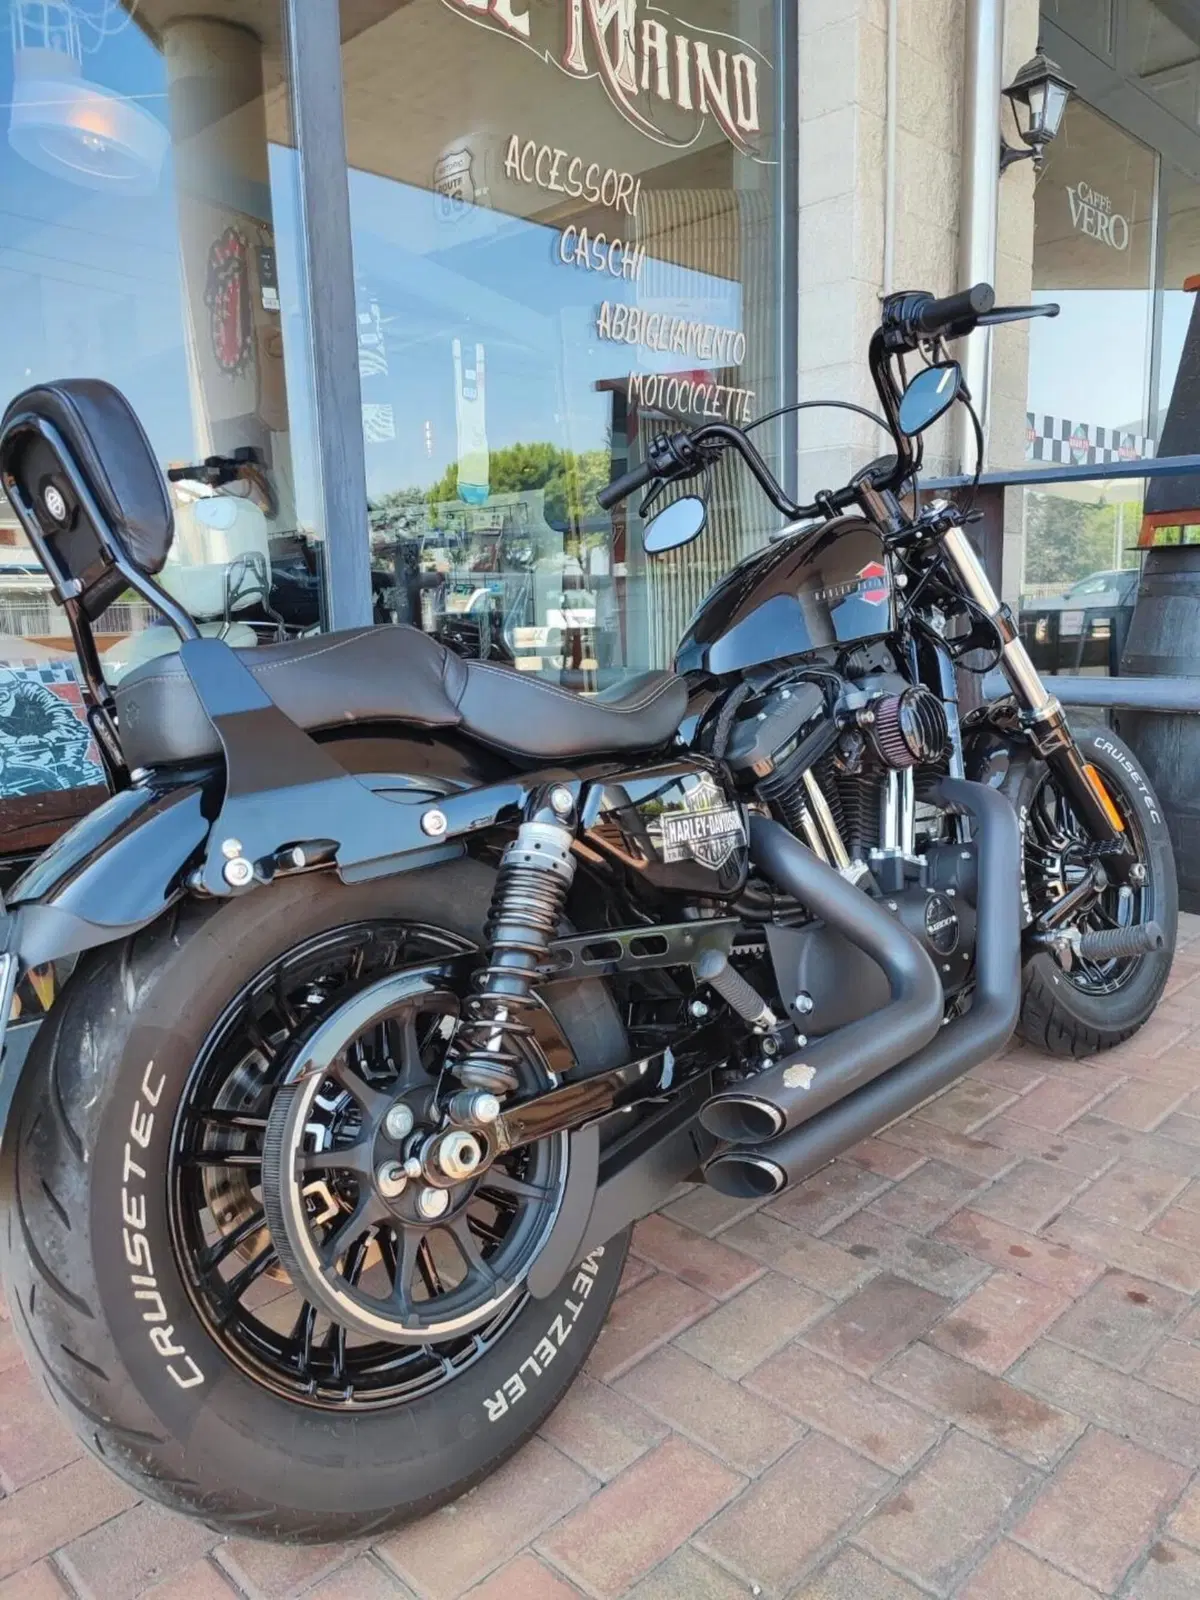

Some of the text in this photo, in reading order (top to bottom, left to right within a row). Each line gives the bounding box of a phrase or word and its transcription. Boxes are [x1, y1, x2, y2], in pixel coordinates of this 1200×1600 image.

[566, 0, 761, 144] MAINO
[504, 134, 641, 216] ACCESSORI
[560, 225, 646, 280] CASCHI
[1065, 186, 1128, 250] VERO
[596, 300, 747, 365] ABBIGLIAMENTO
[628, 371, 755, 423] MOTOCICLETTE
[1094, 737, 1161, 824] CRUISETEC
[121, 1060, 205, 1389] CRUISETEC
[482, 1246, 605, 1422] METZELER
